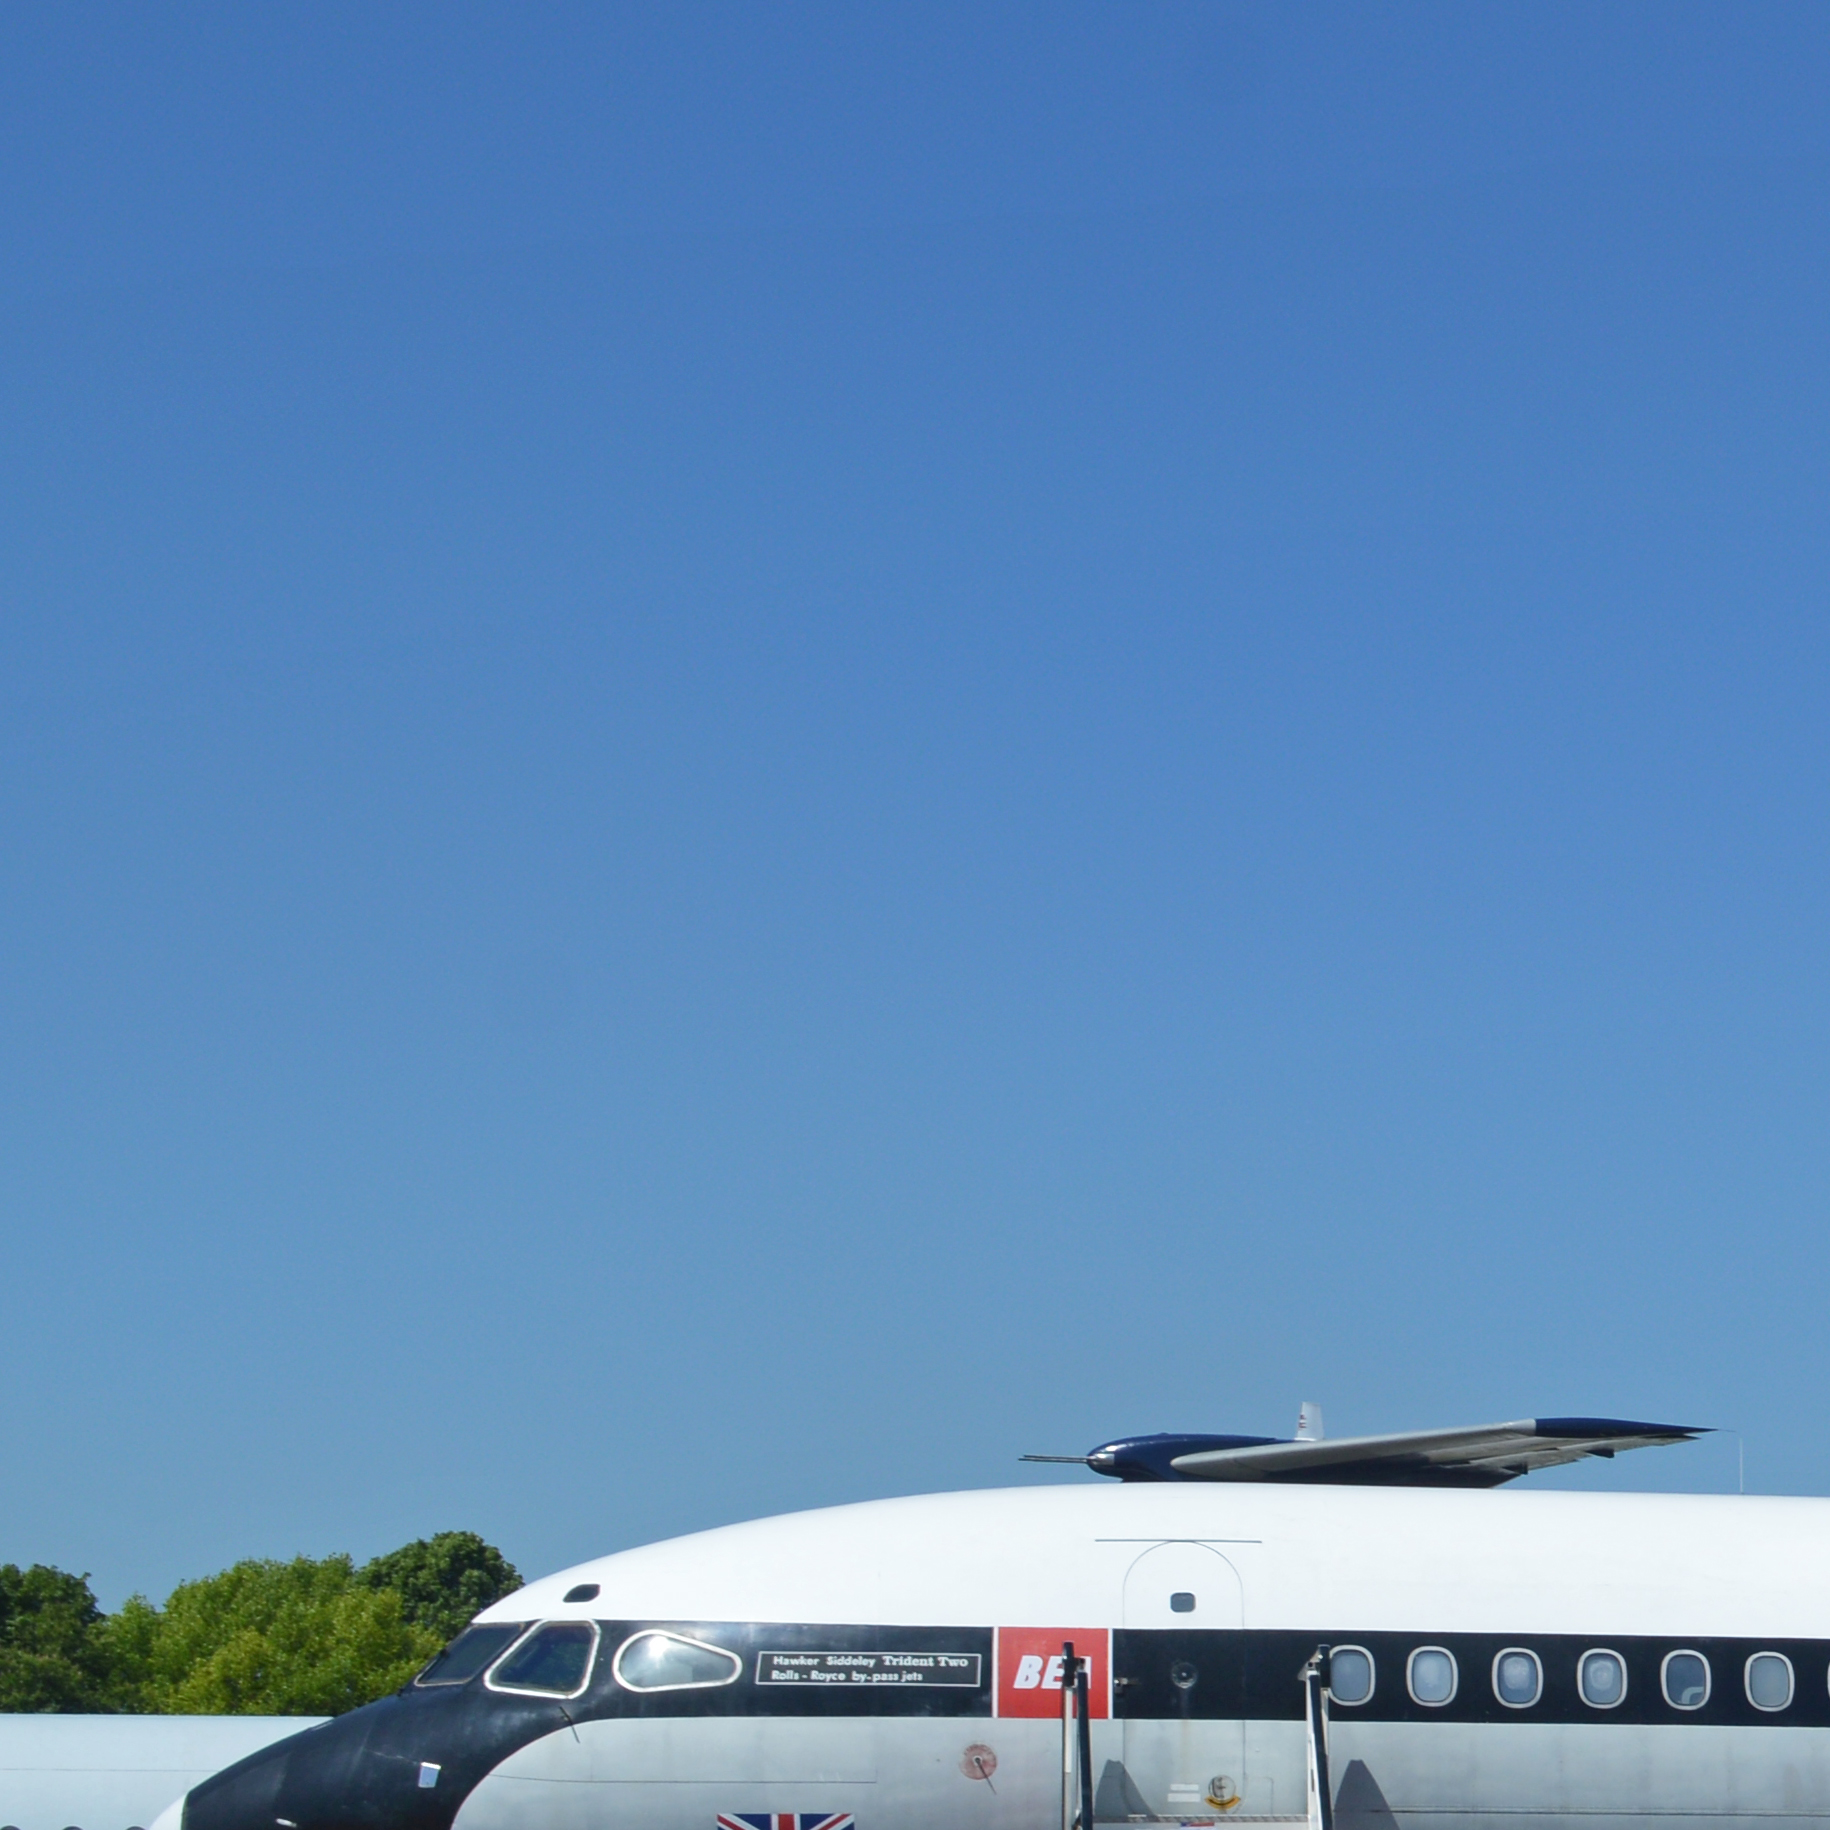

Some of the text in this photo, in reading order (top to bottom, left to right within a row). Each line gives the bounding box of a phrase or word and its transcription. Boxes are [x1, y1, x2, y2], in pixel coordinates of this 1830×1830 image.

[773, 1655, 969, 1668] Hawker Siddeley Trident Two
[901, 1671, 923, 1682] jets
